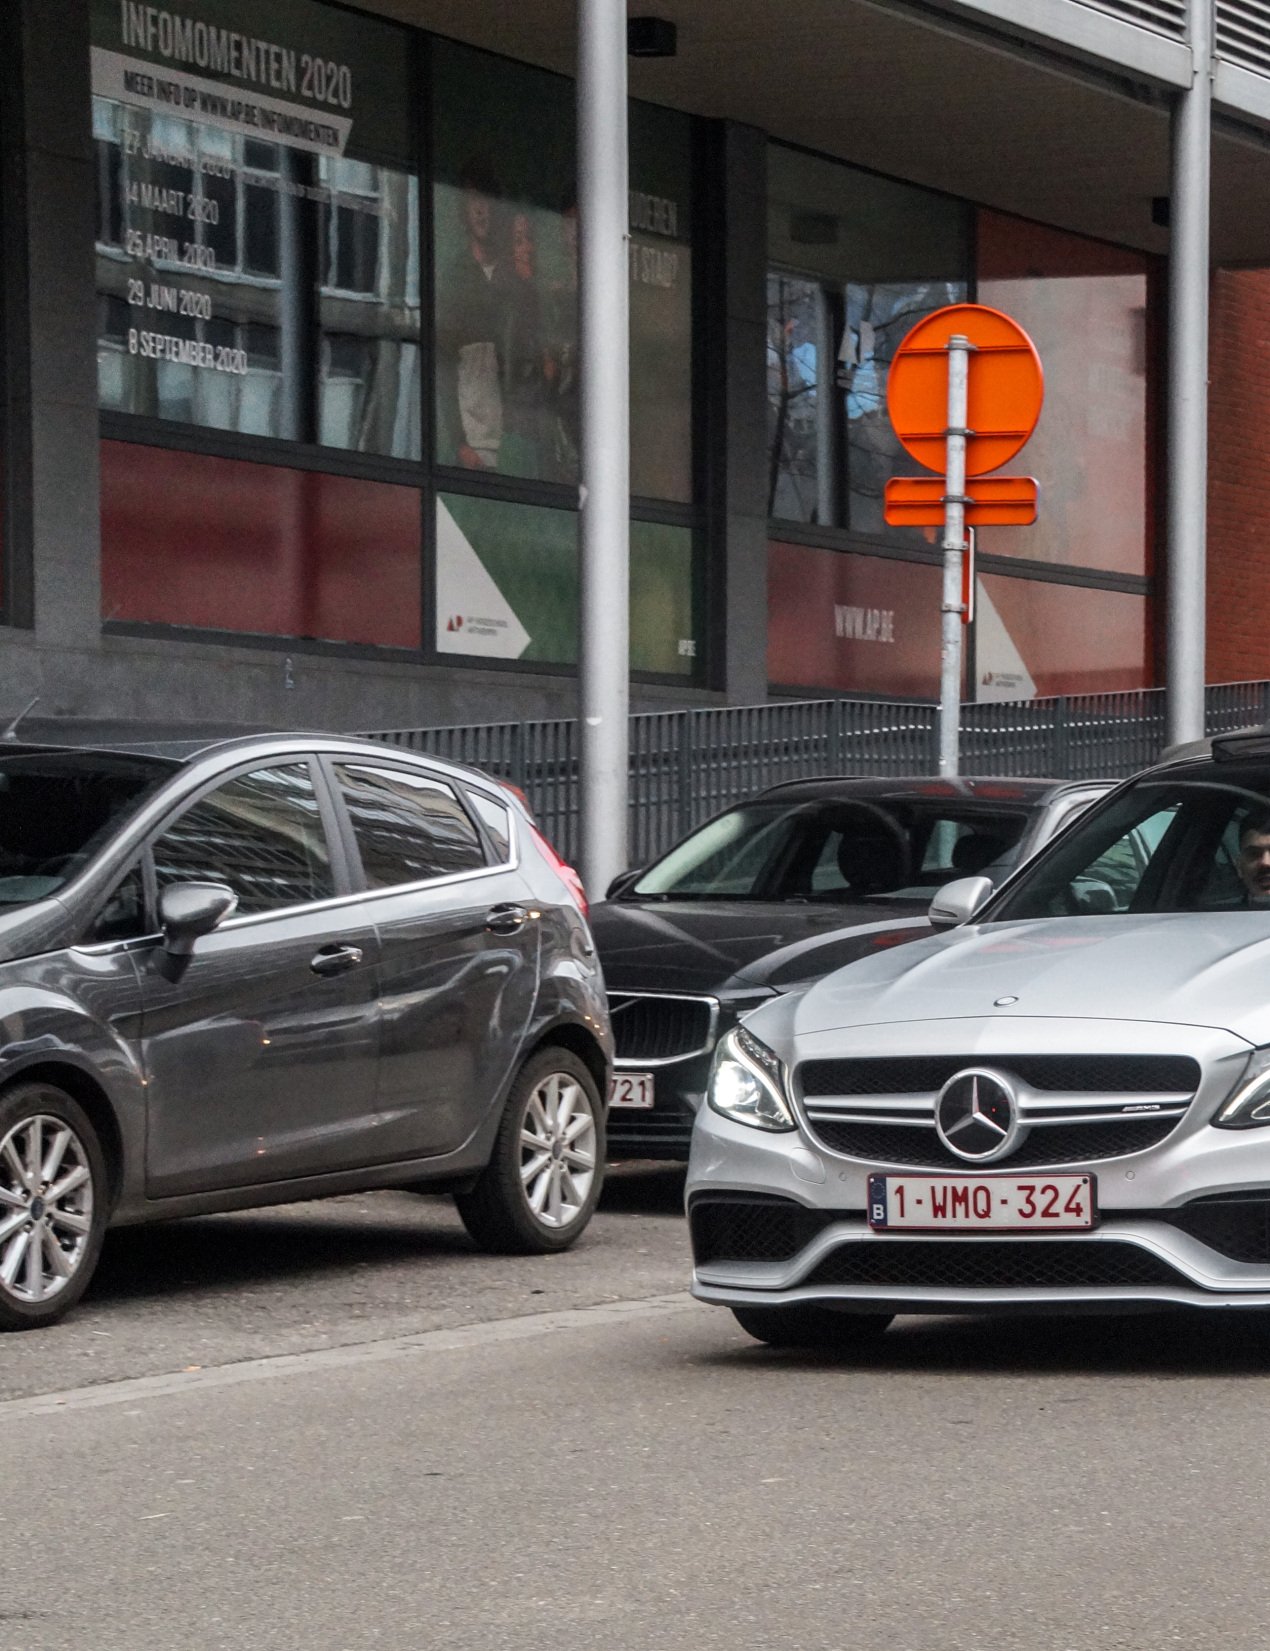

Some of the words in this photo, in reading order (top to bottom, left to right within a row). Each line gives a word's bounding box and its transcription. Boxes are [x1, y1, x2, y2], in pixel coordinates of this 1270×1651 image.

[121, 0, 297, 93] INFOMOMENTEN
[301, 54, 352, 109] 2020
[156, 78, 181, 107] INFO
[183, 86, 198, 110] OP
[140, 183, 185, 217] MAART
[187, 194, 219, 225] 2020
[126, 228, 143, 257] 25
[145, 233, 179, 263] APRIL
[183, 242, 216, 270] 2020
[127, 278, 145, 306] 29
[146, 283, 178, 313] JUNI
[179, 290, 212, 320] 2020
[129, 328, 138, 355] 8
[140, 331, 215, 368] SEPTEMBER
[216, 346, 248, 375] 2020
[872, 1203, 885, 1220] B
[894, 1184, 1084, 1219] 1-WMQ-324
